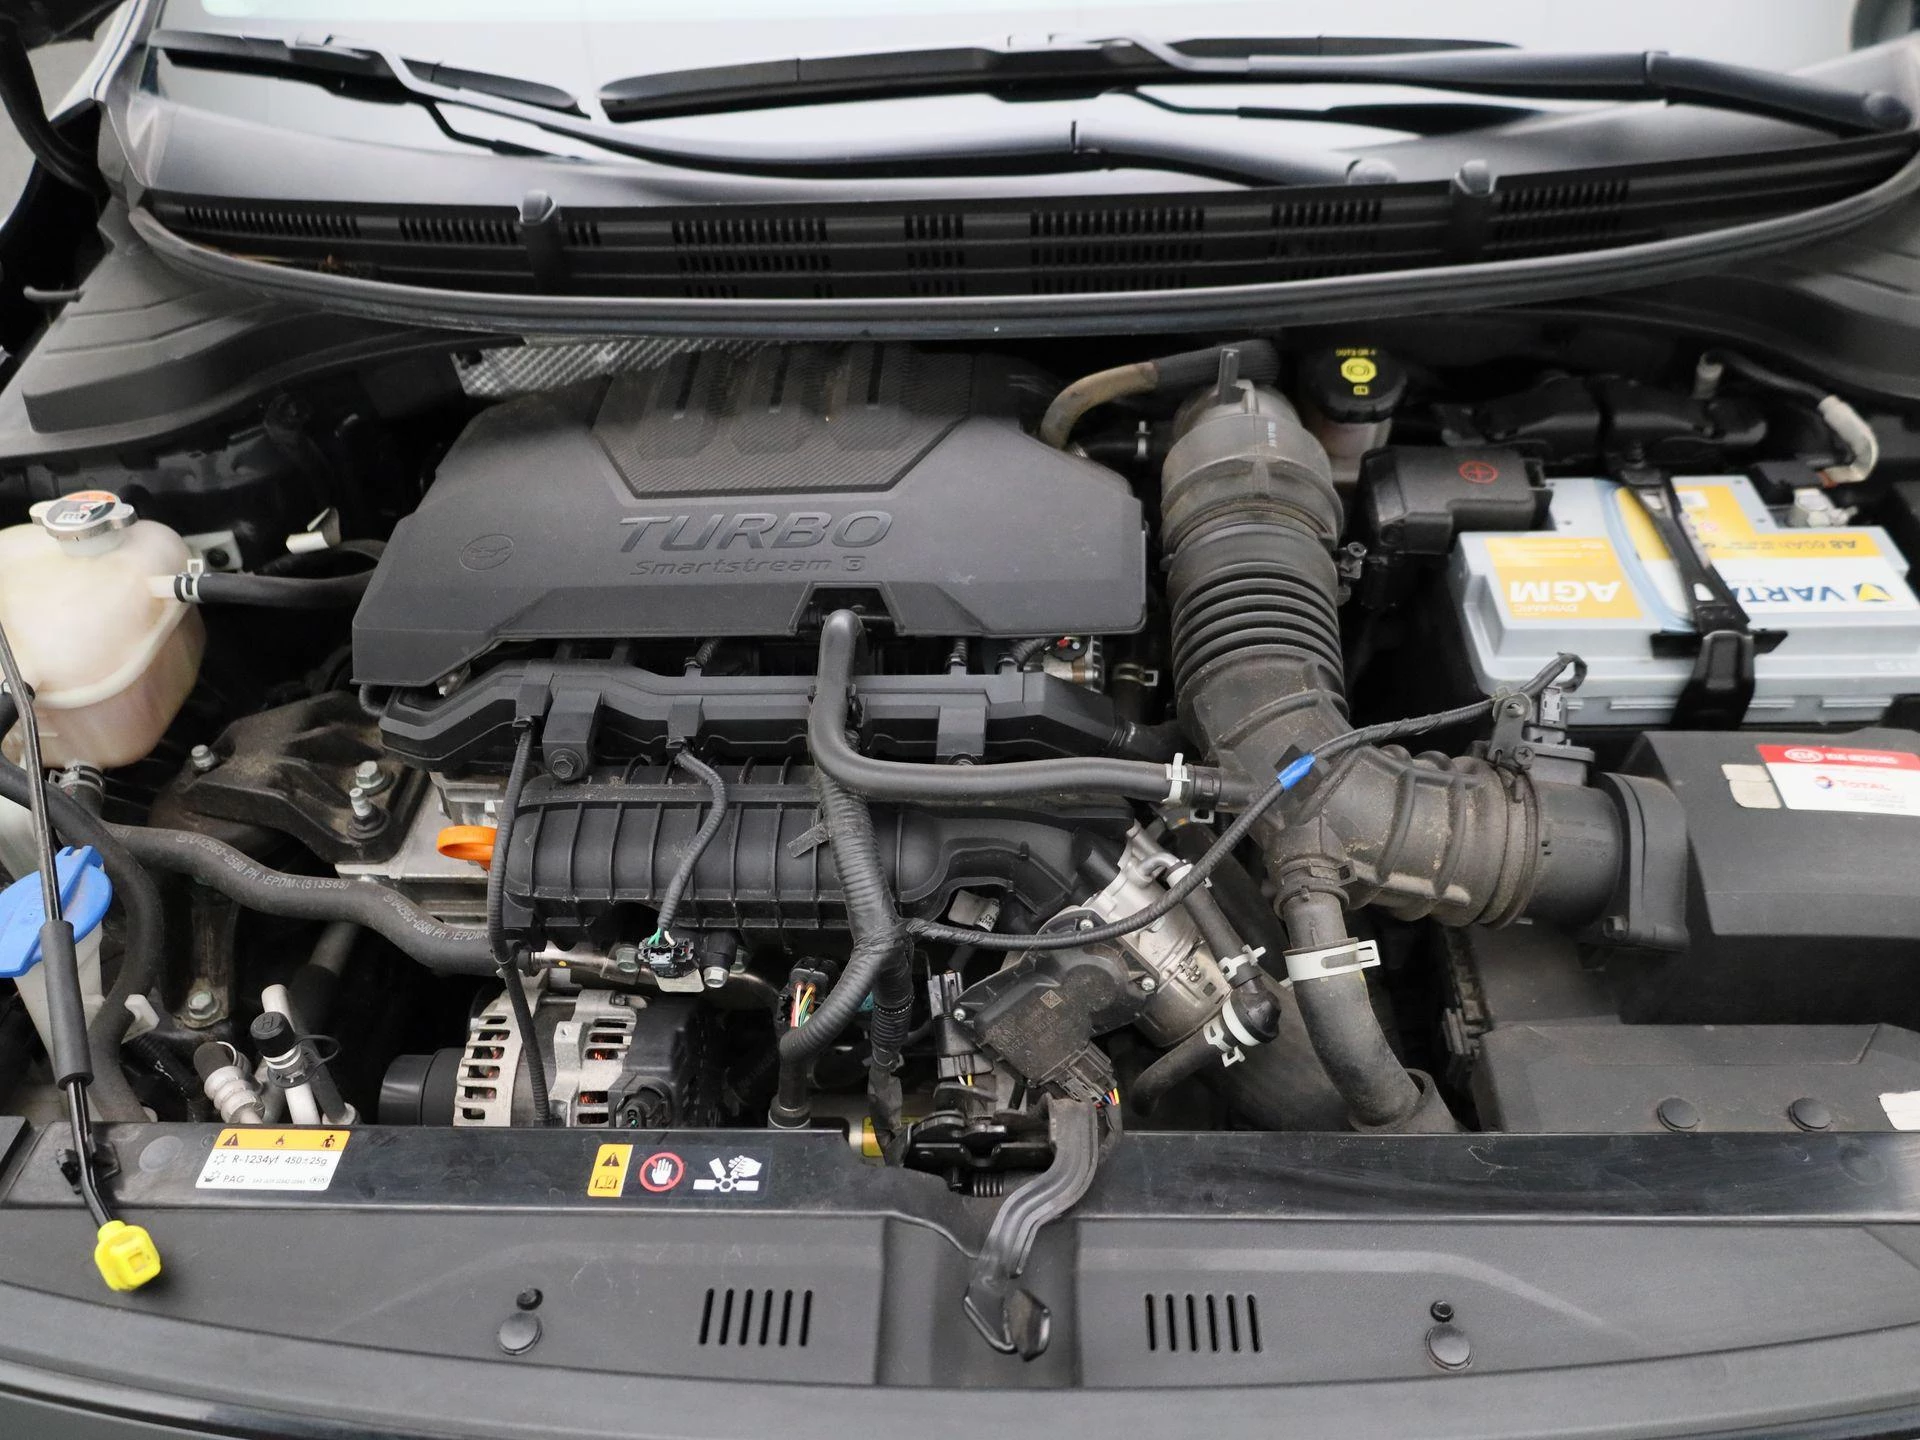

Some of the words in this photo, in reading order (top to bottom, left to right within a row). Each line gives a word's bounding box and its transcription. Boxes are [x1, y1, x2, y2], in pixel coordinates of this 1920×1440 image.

[619, 510, 893, 552] TURBO
[630, 557, 833, 577] Smartstream
[1509, 580, 1622, 603] AGM
[231, 1154, 280, 1166] R-1234yf
[222, 1175, 246, 1184] PAG
